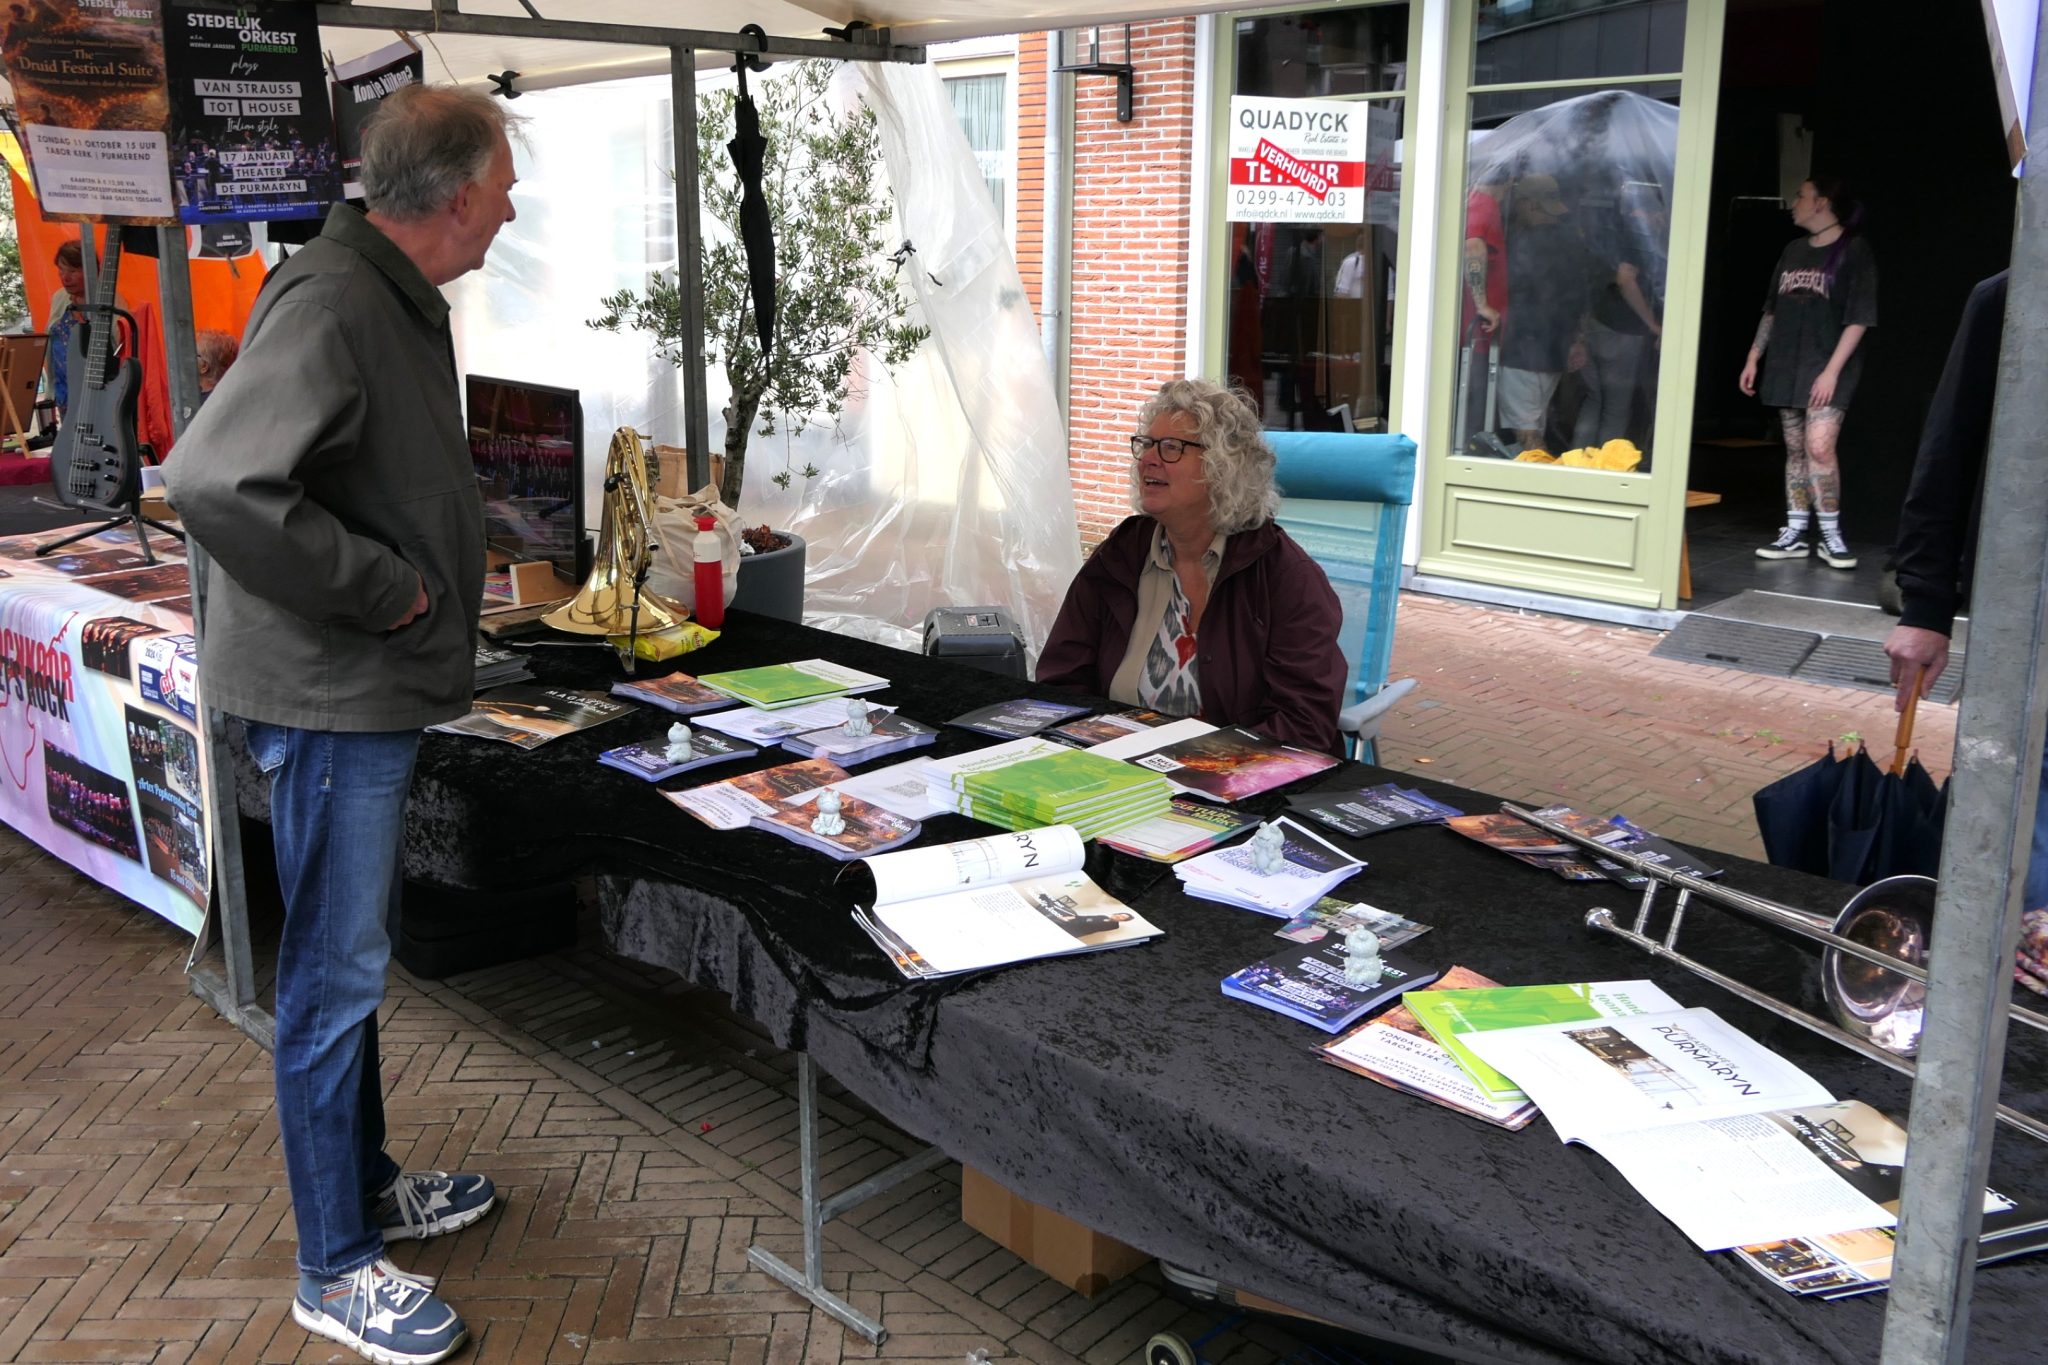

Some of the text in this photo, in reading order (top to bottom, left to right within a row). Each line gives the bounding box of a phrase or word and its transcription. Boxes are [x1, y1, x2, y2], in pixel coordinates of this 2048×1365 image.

[114, 8, 153, 19] ORKEST
[238, 29, 297, 45] ORKEST
[72, 49, 94, 60] The
[241, 43, 298, 54] PURMEREND
[17, 55, 153, 77] Druid Festival Suite
[230, 54, 259, 76] plays
[202, 81, 294, 95] VAN STRAUSS
[209, 102, 294, 113] TOT HOUSE
[226, 117, 255, 133] Italian
[1239, 109, 1349, 133] QUADYCK
[37, 134, 71, 146] ZONDAG
[85, 140, 122, 149] OKTOBER
[126, 141, 136, 149] 15
[139, 141, 157, 149] UUR
[46, 147, 151, 161] TABOR KERK PURMEREND
[224, 152, 291, 162] 17 JANUARI
[235, 167, 283, 177] THEATER
[1245, 161, 1271, 183] TE
[1261, 142, 1328, 194] VERHUURD
[221, 181, 302, 193] DE PURMARYN
[1235, 208, 1346, 221] info@qdck.nl www.qdck.nl
[26, 665, 70, 723] ROCK
[1191, 812, 1242, 827] MARKT
[1378, 1029, 1423, 1049] ZONDAG
[1380, 1037, 1412, 1052] TABOR
[1415, 1050, 1443, 1063] KERK
[1651, 1026, 1761, 1096] PURMARYN
[1808, 1135, 1843, 1161] Jones
